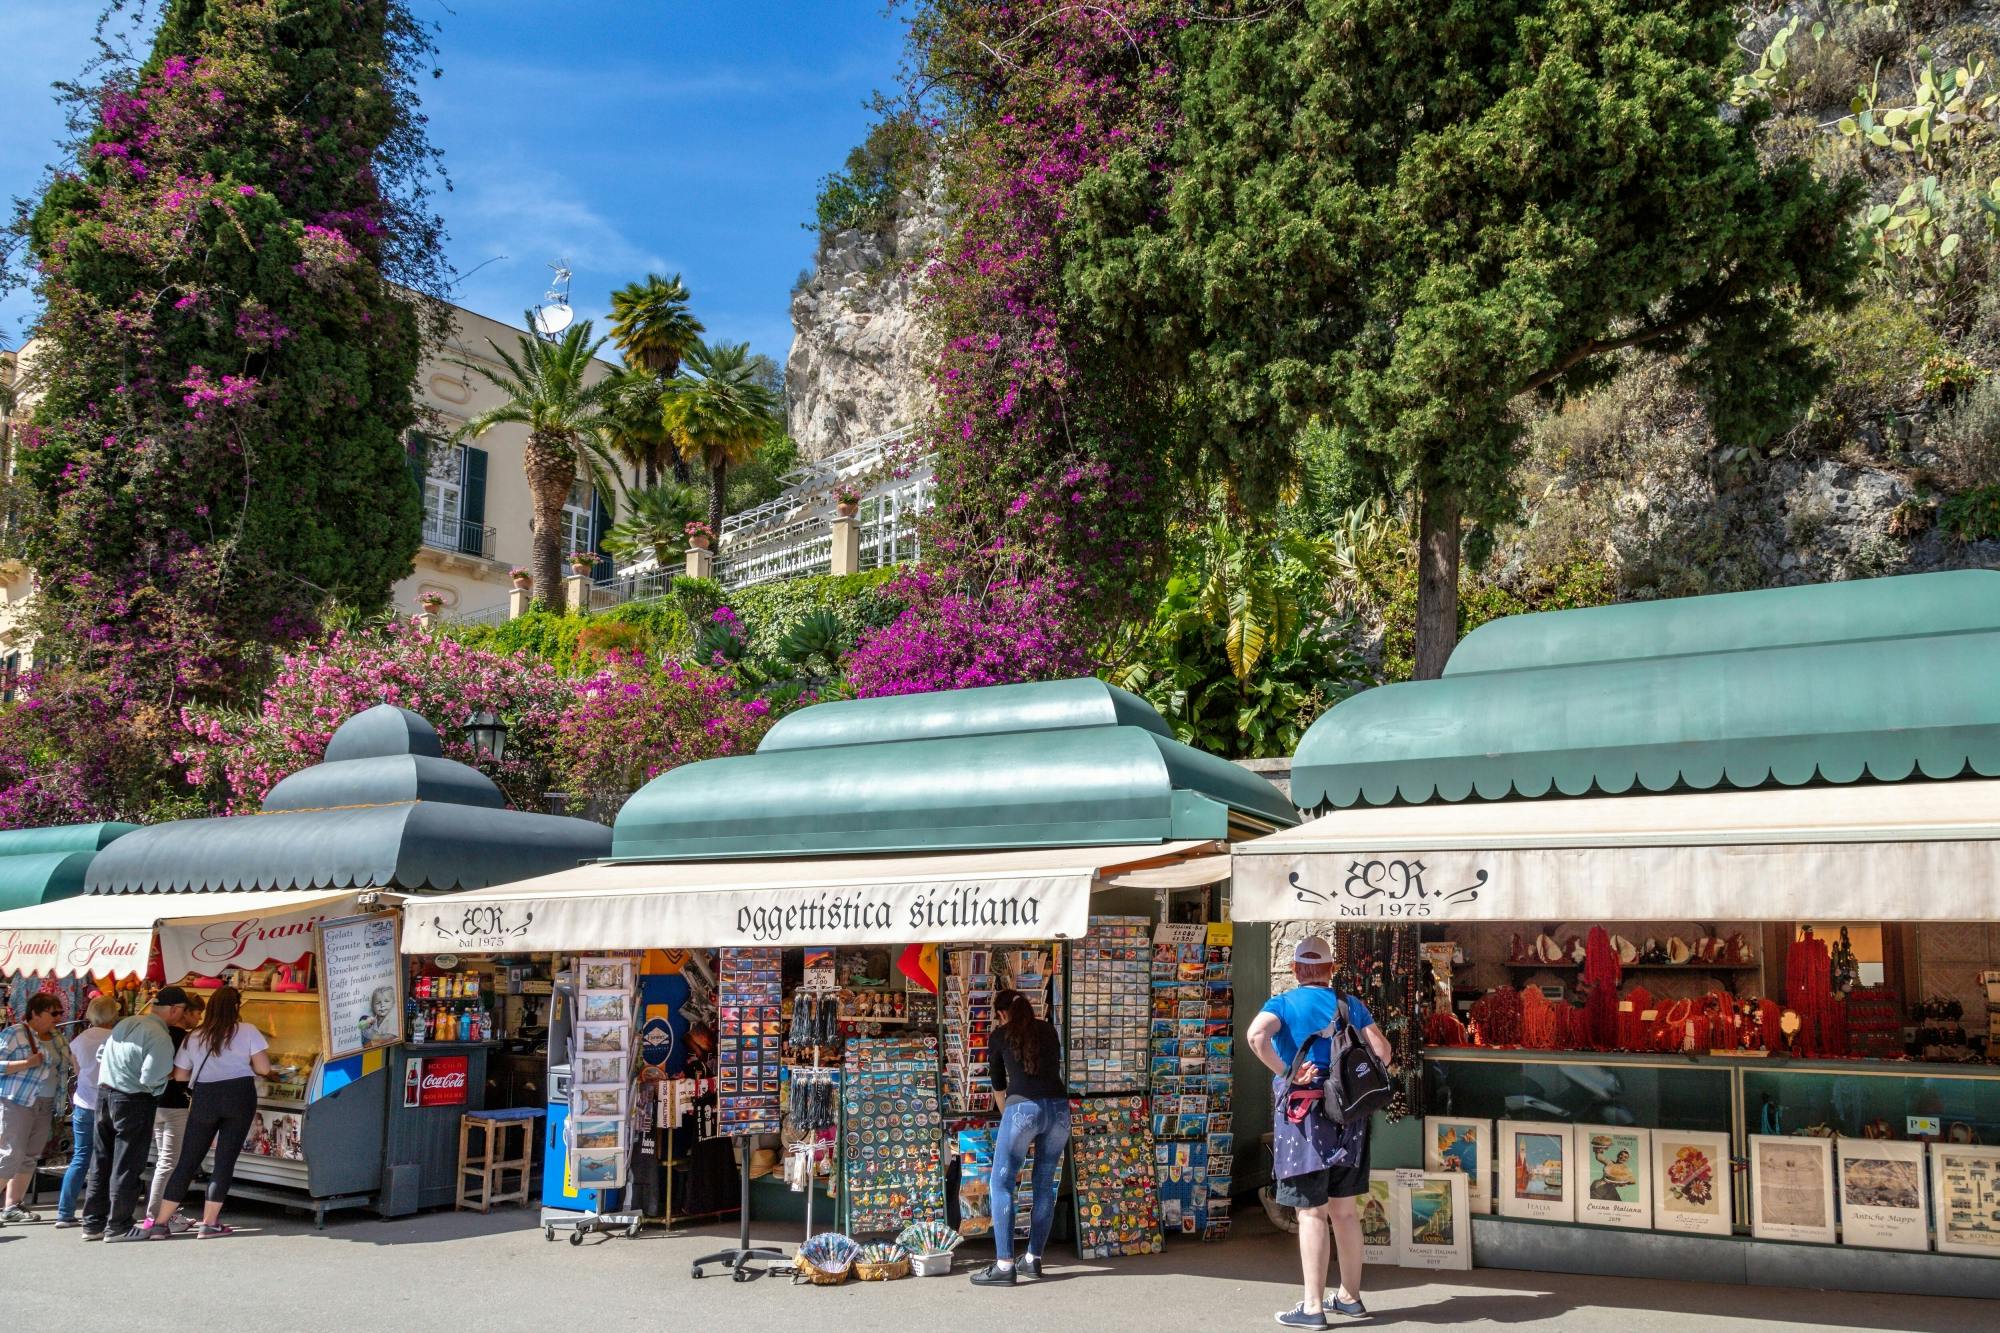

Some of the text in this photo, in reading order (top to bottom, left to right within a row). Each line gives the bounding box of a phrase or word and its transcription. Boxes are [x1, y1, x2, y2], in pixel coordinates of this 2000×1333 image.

[736, 886, 1041, 941] oggettistica siciliana
[1339, 903, 1431, 917] dal 1975
[191, 915, 327, 963] Grani
[326, 930, 353, 941] Gelati
[327, 941, 360, 954] Granite
[459, 937, 504, 948] dal 1975
[68, 934, 139, 967] Gelati
[327, 950, 380, 964] Orange juice
[331, 988, 360, 1001] Latte di
[333, 1011, 351, 1021] Toast
